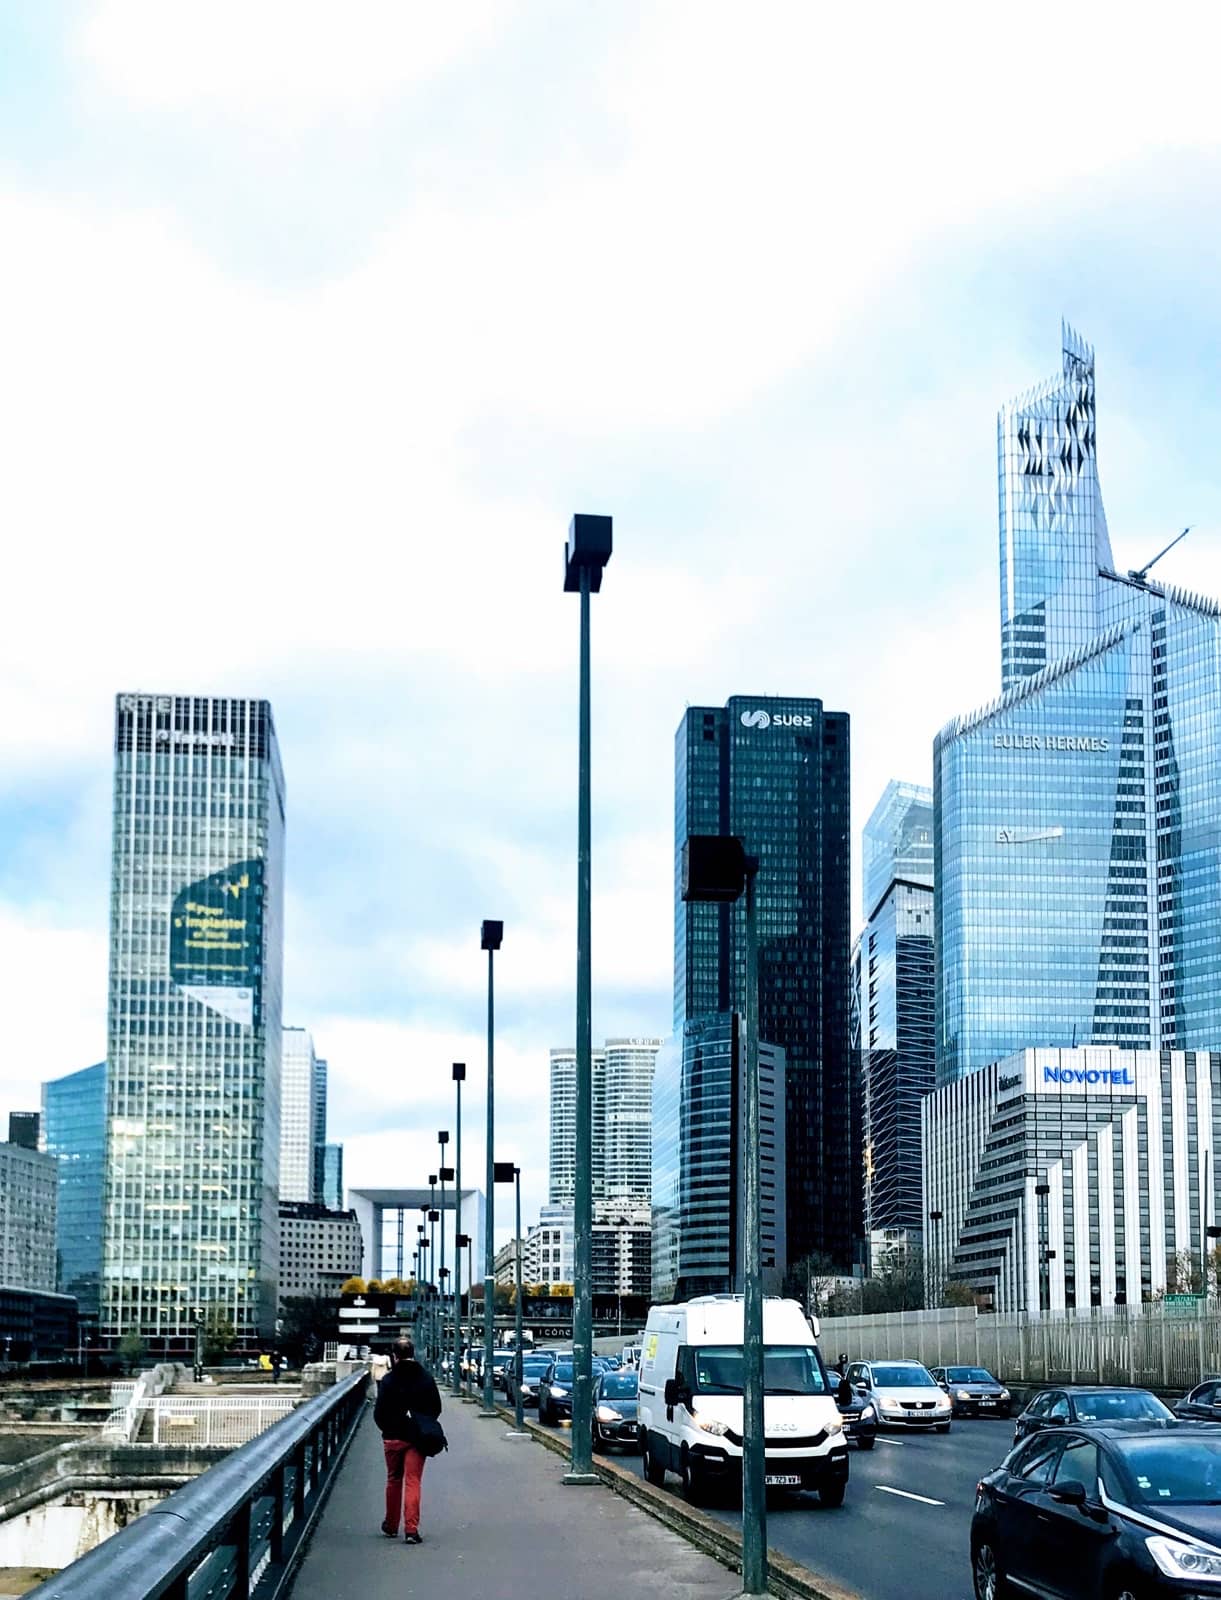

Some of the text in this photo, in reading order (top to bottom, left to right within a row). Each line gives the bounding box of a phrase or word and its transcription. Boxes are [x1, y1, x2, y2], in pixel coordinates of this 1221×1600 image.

[120, 697, 171, 712] RTE
[773, 714, 813, 727] suez
[994, 735, 1110, 752] EULER HERMES
[1044, 1066, 1134, 1085] NOVOTEL
